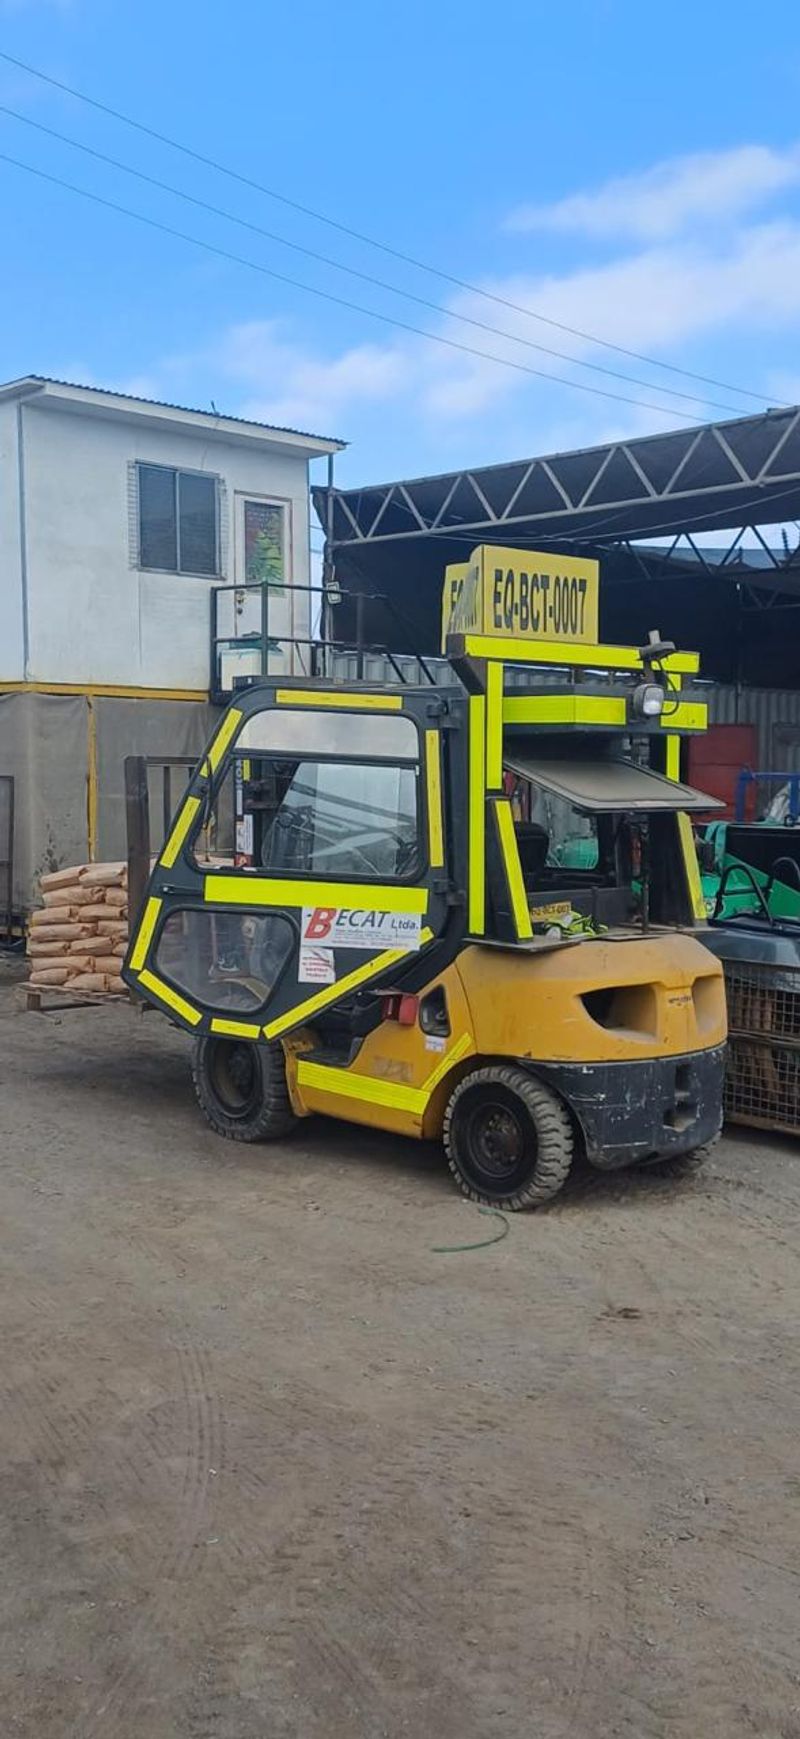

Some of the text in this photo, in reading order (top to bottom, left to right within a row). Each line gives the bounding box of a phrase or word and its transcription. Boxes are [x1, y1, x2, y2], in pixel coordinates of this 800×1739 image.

[494, 568, 587, 635] EQ-BCT-0007
[304, 907, 391, 939] BECAT
[391, 918, 419, 930] Ltda.
